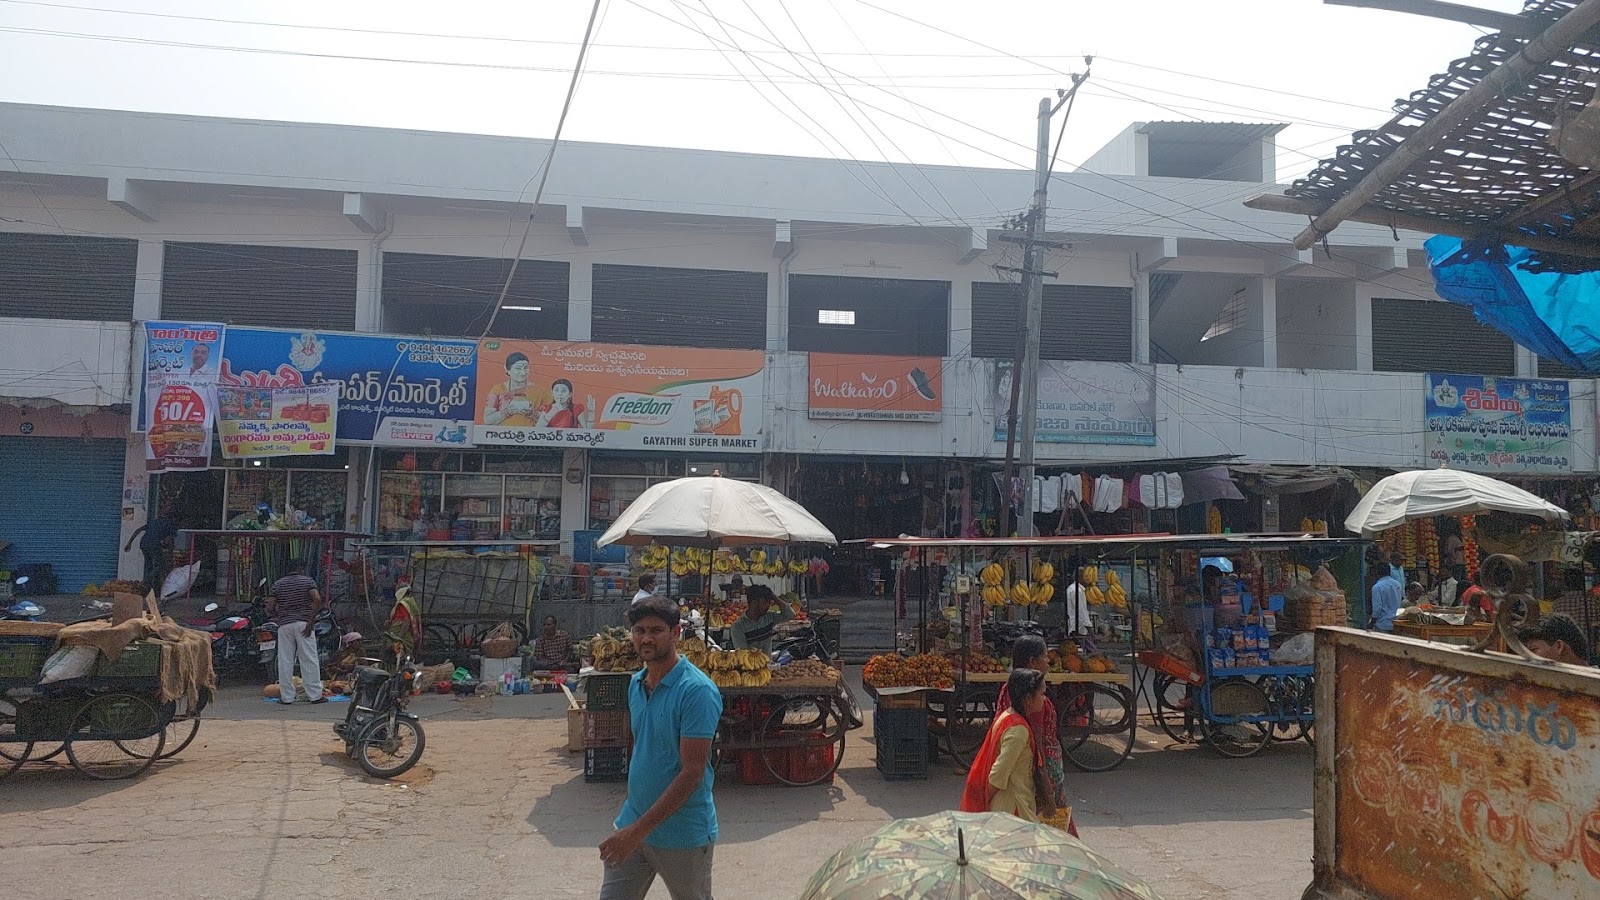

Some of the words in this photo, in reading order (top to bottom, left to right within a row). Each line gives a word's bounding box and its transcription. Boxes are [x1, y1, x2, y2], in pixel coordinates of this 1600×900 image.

[610, 397, 673, 415] Freedom
[485, 430, 526, 443] గాయత్రి
[528, 430, 564, 442] సూపర్
[566, 431, 606, 446] మార్కెట్
[643, 436, 686, 446] GAYATHRI
[689, 437, 718, 447] SUPER
[722, 438, 757, 448] MARKET
